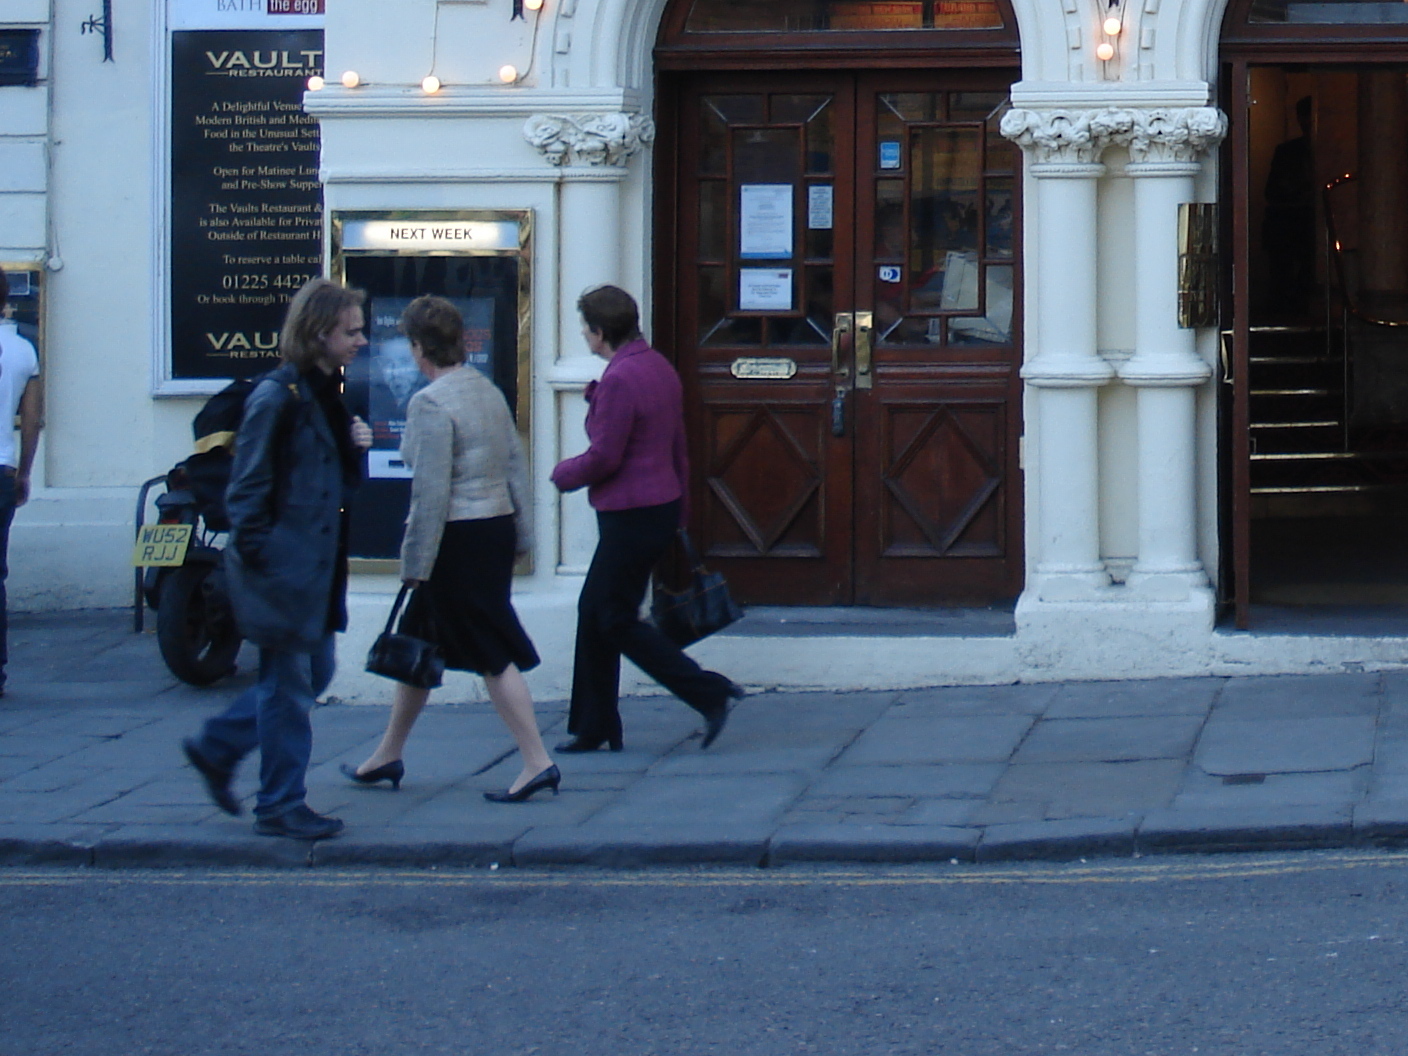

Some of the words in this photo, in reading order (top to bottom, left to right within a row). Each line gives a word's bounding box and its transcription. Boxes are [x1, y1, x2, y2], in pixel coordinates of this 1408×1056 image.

[205, 50, 323, 68] VAULT
[228, 69, 323, 77] RESTAURANT
[211, 102, 220, 111] A
[222, 101, 270, 114] Delightful
[273, 101, 302, 111] Venue
[195, 115, 232, 125] Modern
[235, 115, 267, 125] British
[269, 115, 286, 125] and
[204, 128, 228, 139] Food
[230, 128, 240, 139] in
[242, 128, 256, 139] the
[259, 128, 298, 139] Unusual
[229, 142, 243, 152] the
[246, 142, 288, 152] Theatre's
[213, 166, 239, 178] Open
[241, 166, 255, 176] for
[258, 166, 296, 176] Matinee
[221, 179, 239, 190] and
[241, 179, 287, 190] Pre-Show
[209, 203, 228, 213] The
[230, 203, 258, 213] Vaults
[261, 203, 311, 213] Restaurant
[313, 203, 322, 213] &
[199, 217, 207, 227] is
[209, 217, 229, 227] also
[231, 217, 275, 227] Available
[278, 217, 292, 227] for
[208, 230, 244, 241] Outside
[247, 230, 258, 241] of
[260, 230, 309, 241] Restaurant
[390, 228, 427, 240] NEXT
[431, 228, 473, 240] WEEK
[223, 254, 236, 264] To
[238, 254, 272, 264] reserve
[282, 254, 306, 264] table
[222, 275, 268, 289] 01225
[197, 294, 210, 304] Or
[213, 294, 236, 304] book
[239, 294, 276, 306] through
[206, 332, 279, 350] VAU
[142, 527, 188, 543] WU52
[141, 545, 178, 561] RJJ
